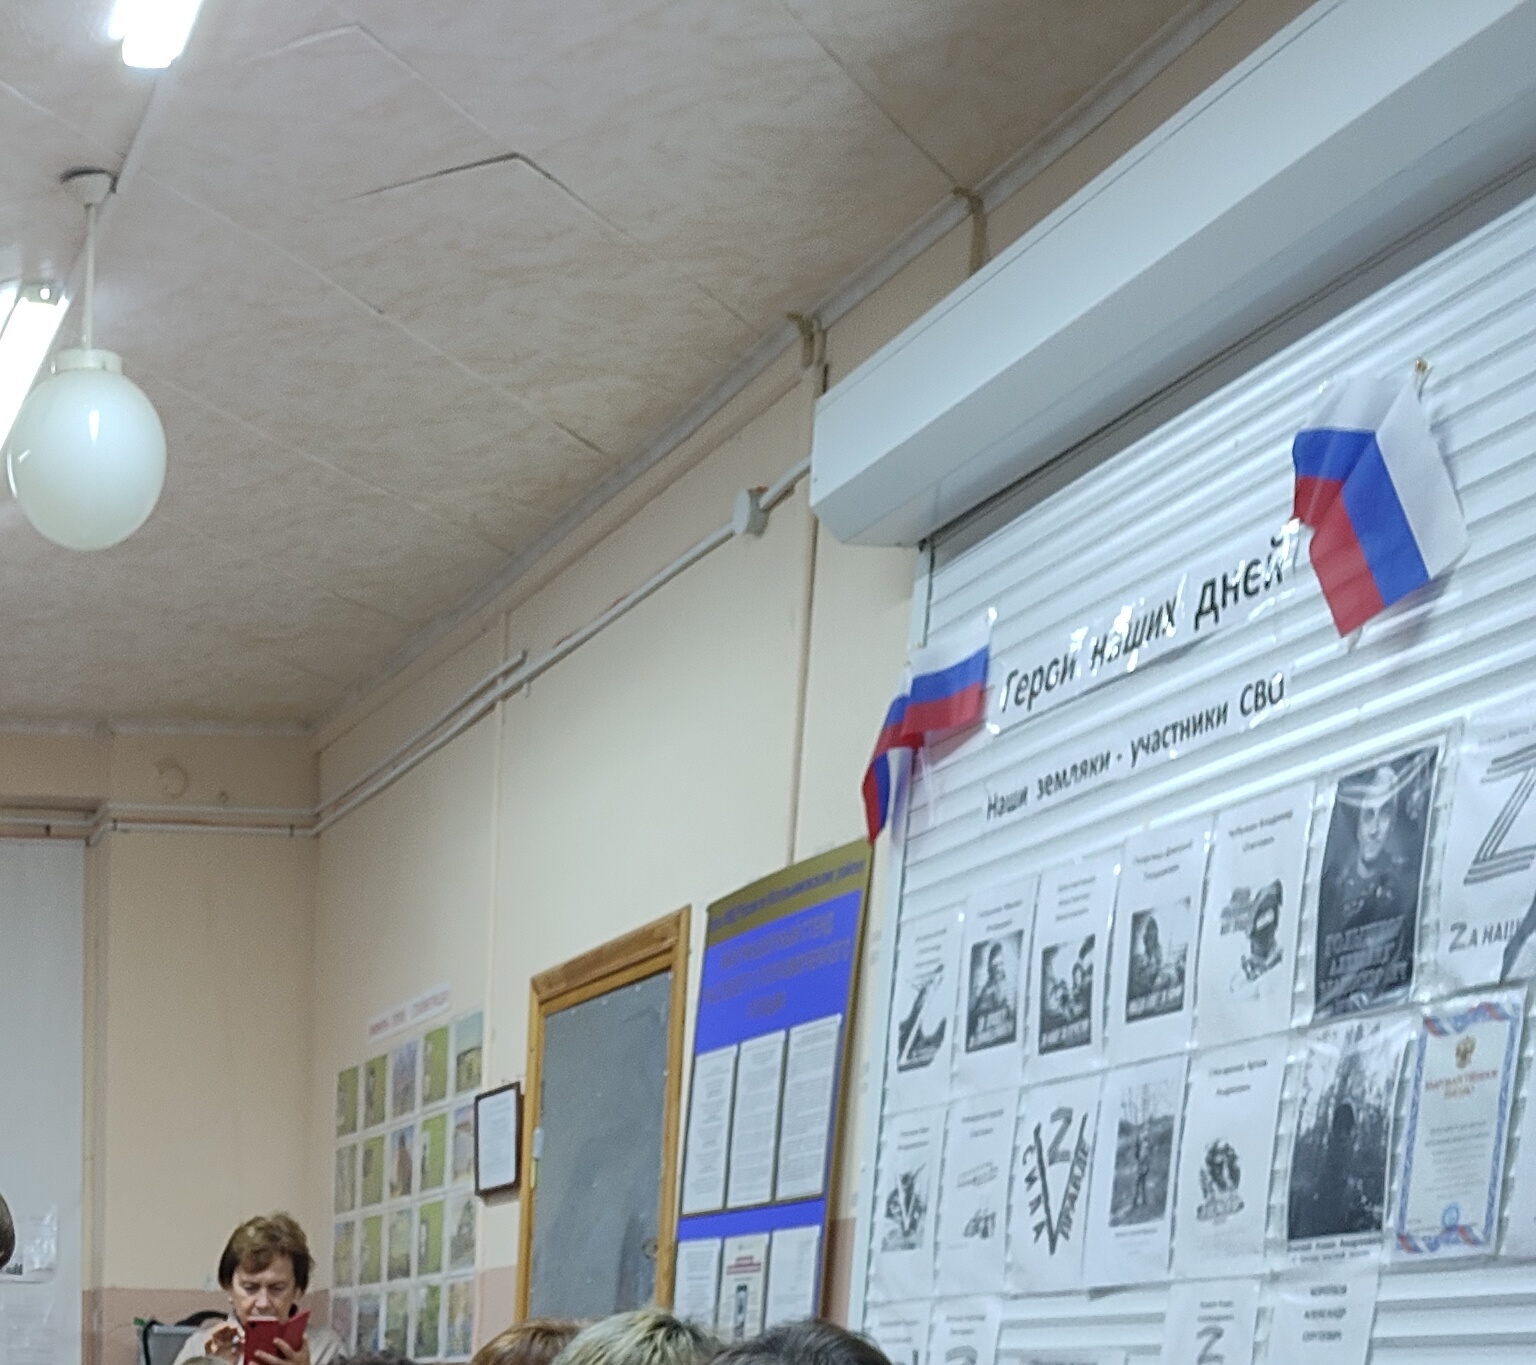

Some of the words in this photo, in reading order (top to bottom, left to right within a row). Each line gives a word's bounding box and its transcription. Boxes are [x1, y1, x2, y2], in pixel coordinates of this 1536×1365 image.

[1001, 652, 1078, 713] Герои
[1089, 596, 1177, 671] наших
[1194, 534, 1286, 632] дней
[986, 787, 1028, 821] Наши
[1036, 750, 1111, 800] земляки
[1130, 701, 1229, 768] участники
[1239, 672, 1286, 718] СВО
